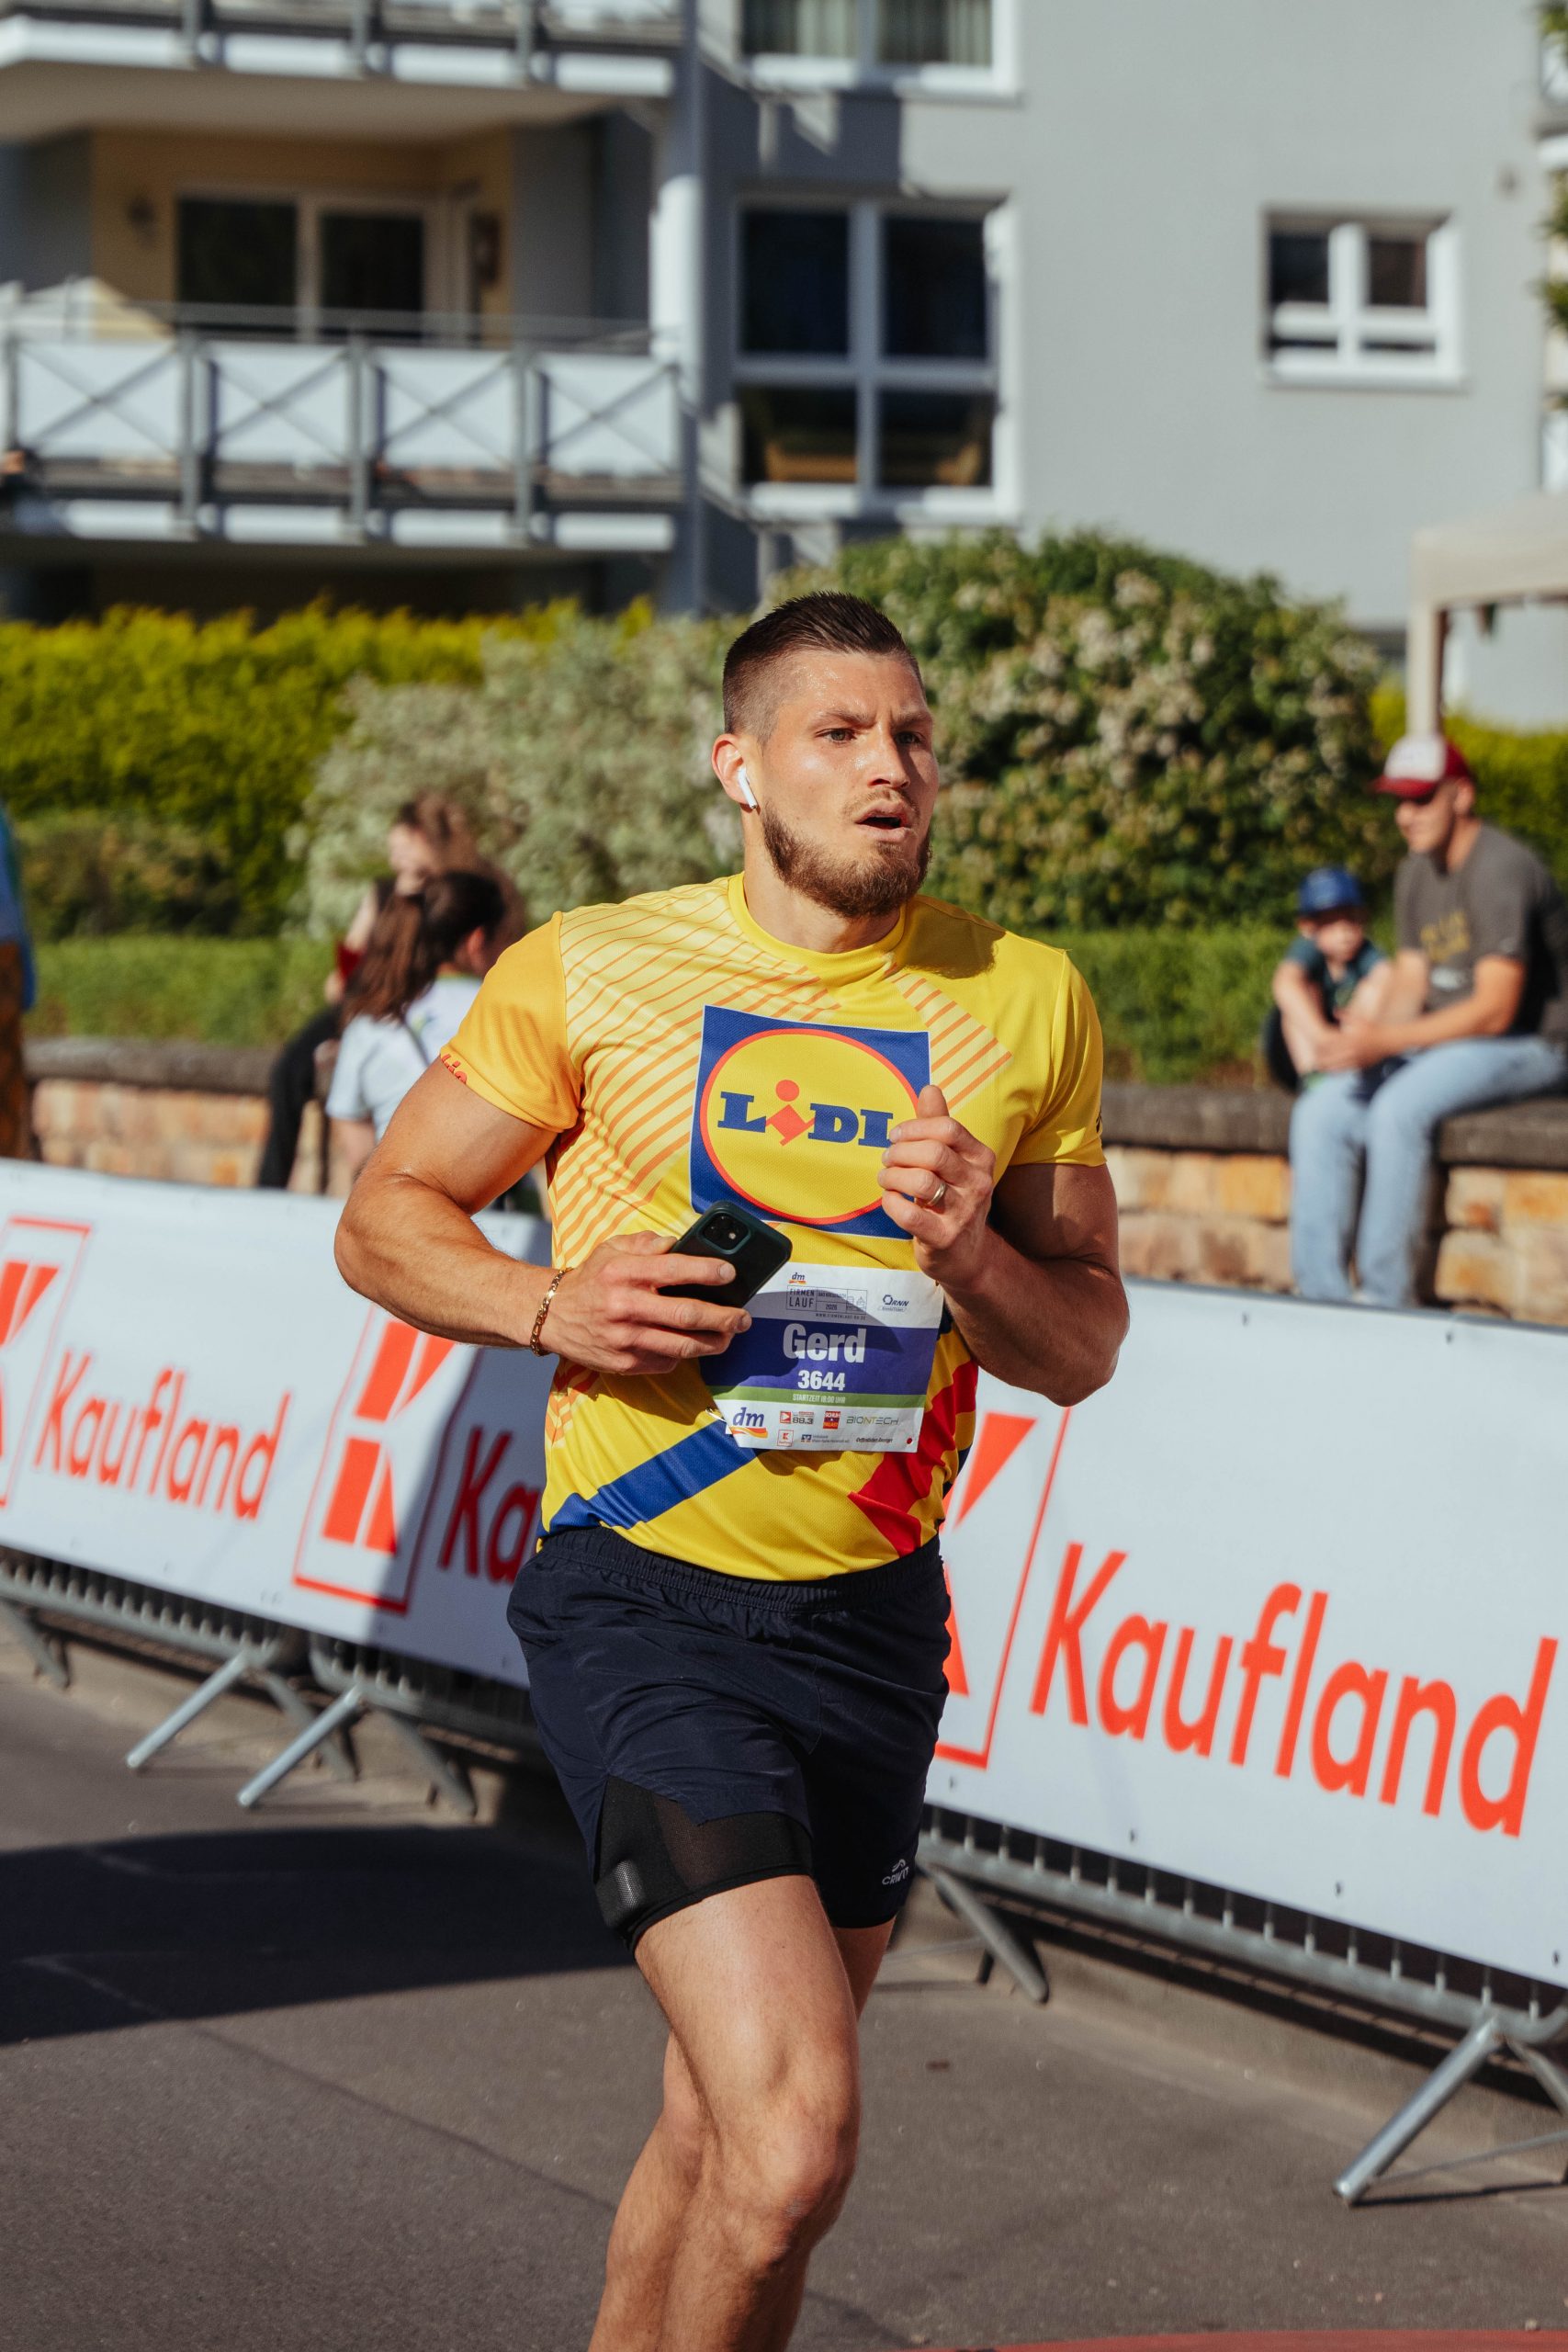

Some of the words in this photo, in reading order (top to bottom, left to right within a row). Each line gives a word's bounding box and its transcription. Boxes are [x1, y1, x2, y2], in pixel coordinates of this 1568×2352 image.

[789, 1296, 814, 1308] LAUF
[790, 1288, 815, 1296] FIRMEN
[783, 1322, 866, 1363] Gerd
[797, 1369, 846, 1392] 3644
[793, 1393, 820, 1403] STARTZEIT
[732, 1407, 765, 1427] dm
[34, 1349, 291, 1521] Kaufland
[1029, 1542, 1559, 1838] Kaufland
